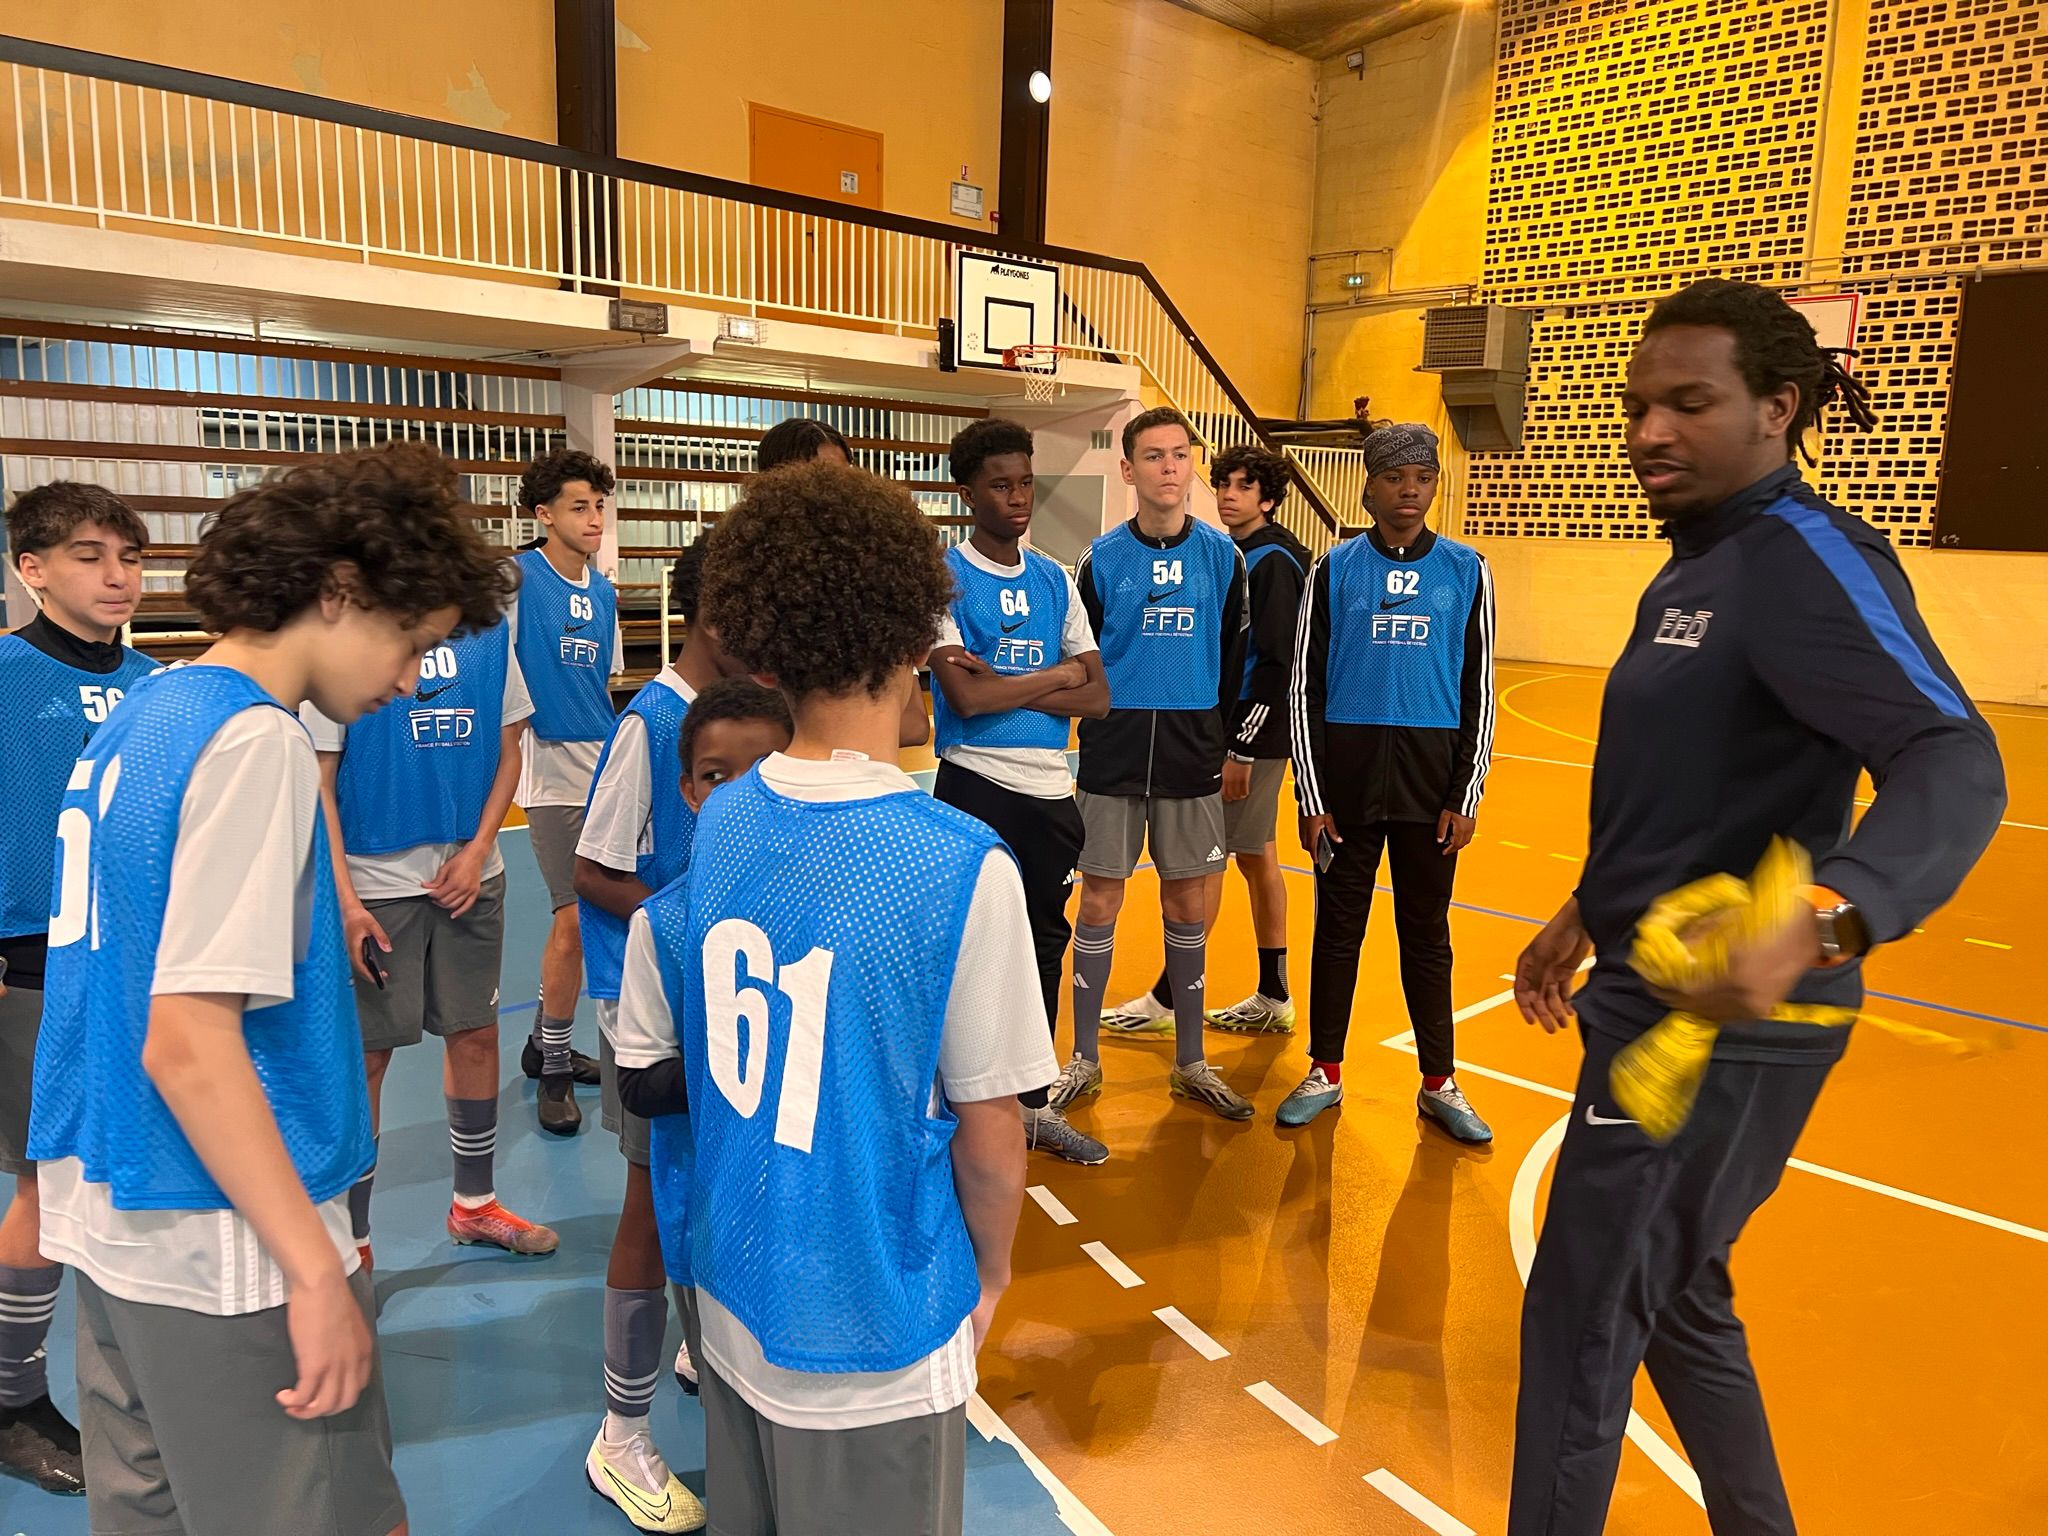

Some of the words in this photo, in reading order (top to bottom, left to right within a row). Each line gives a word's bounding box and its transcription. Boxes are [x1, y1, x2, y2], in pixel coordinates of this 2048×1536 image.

[1152, 560, 1184, 585] 54
[1387, 569, 1420, 595] 62
[570, 593, 593, 621] 63
[1000, 588, 1030, 617] 64
[1142, 612, 1195, 632] FFD
[1372, 620, 1430, 640] FFD
[1656, 614, 1709, 641] FFD
[420, 647, 458, 680] 60
[560, 642, 597, 664] FFD
[993, 643, 1045, 667] FFD
[410, 716, 473, 741] FFD
[703, 918, 834, 1154] 61
